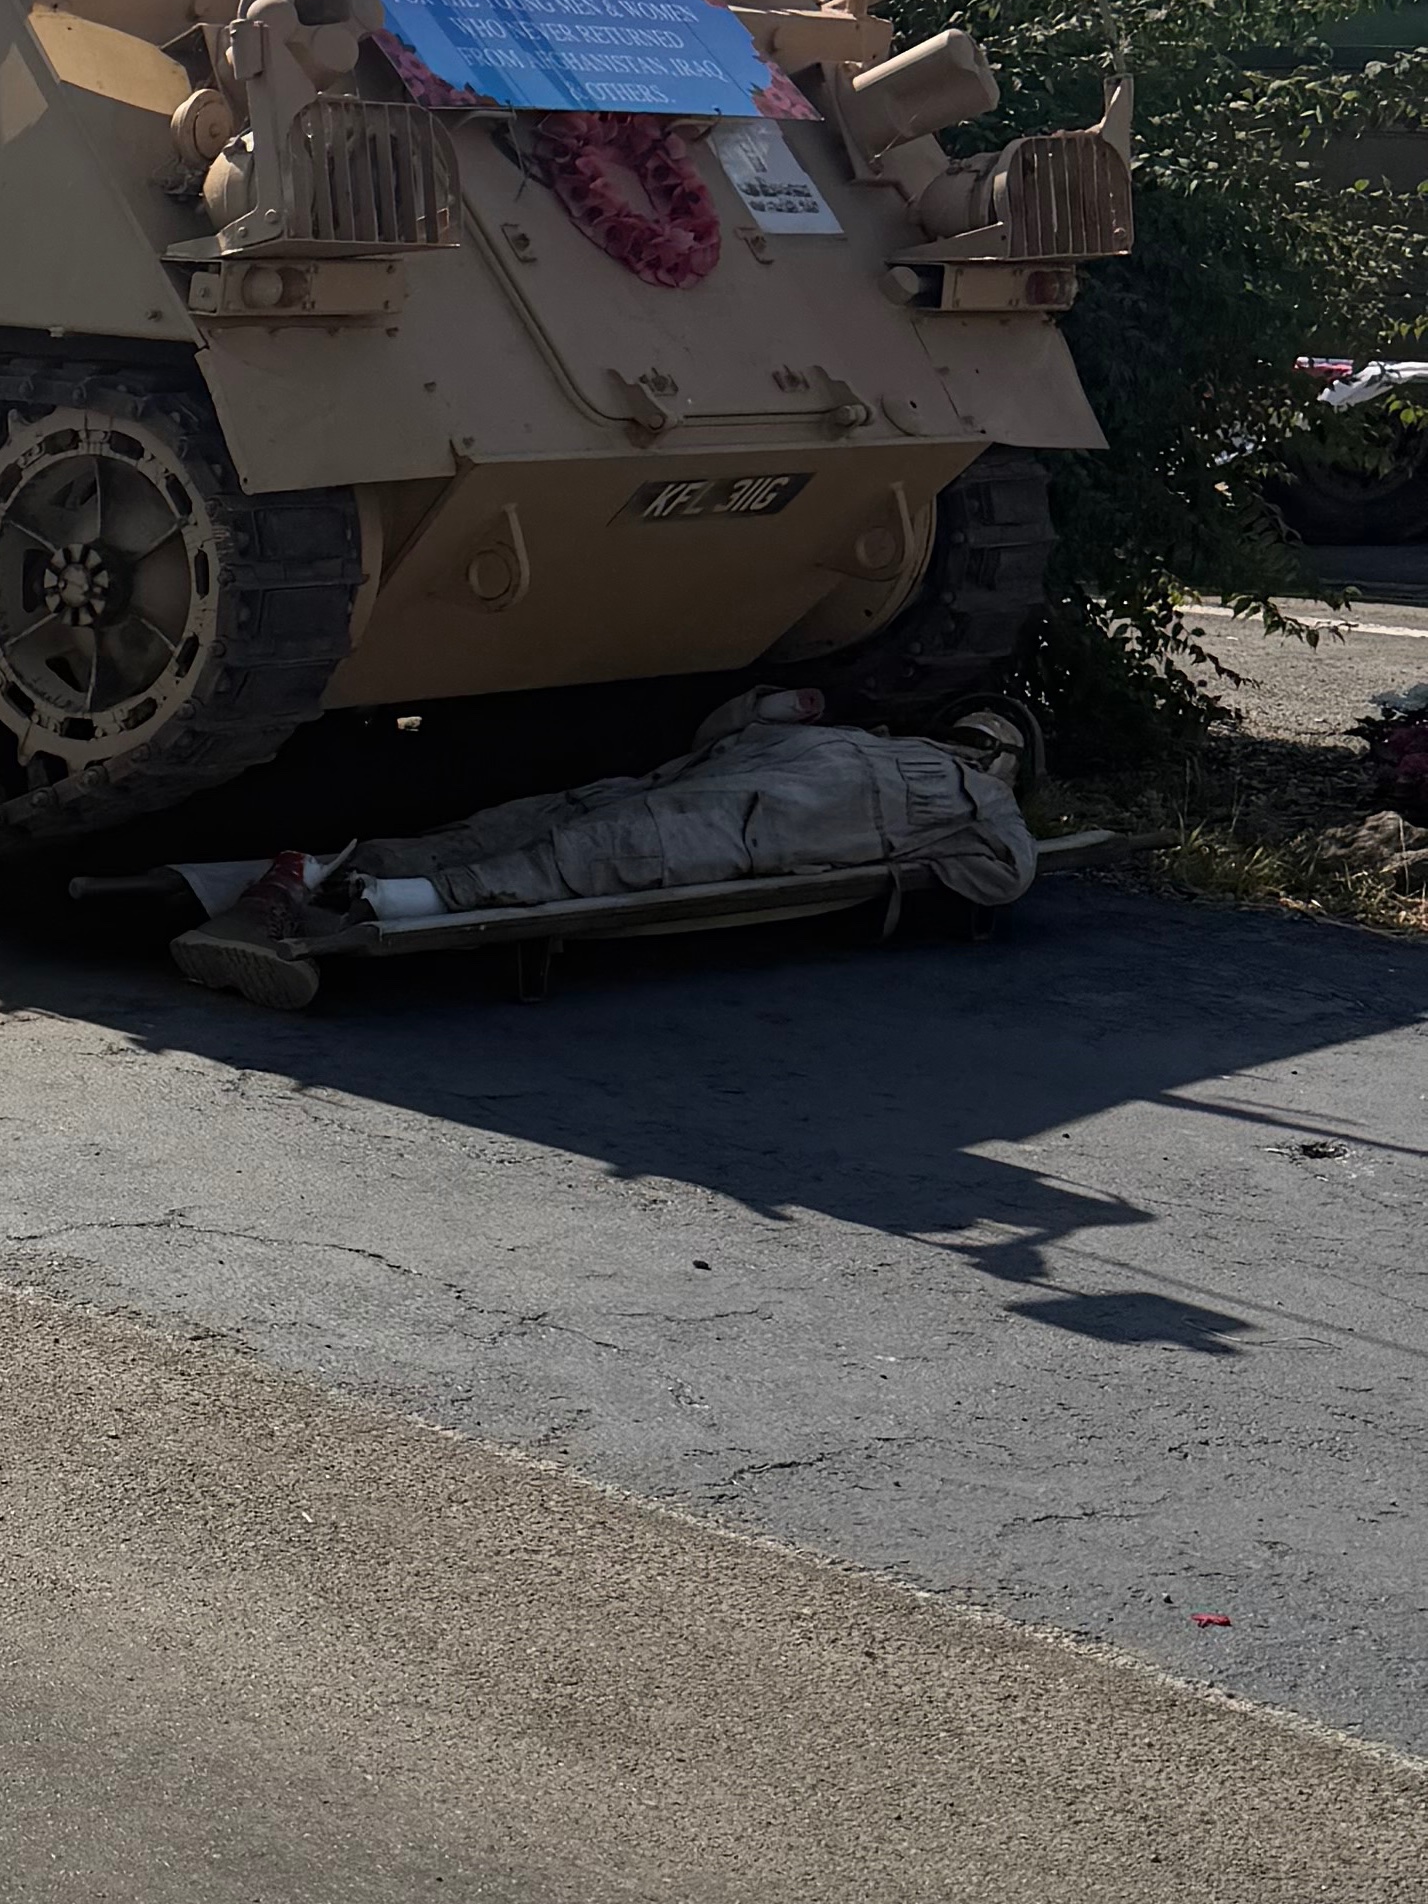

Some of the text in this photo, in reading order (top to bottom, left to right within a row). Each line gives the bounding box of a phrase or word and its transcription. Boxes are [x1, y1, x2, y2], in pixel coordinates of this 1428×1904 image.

[602, 0, 625, 18] &
[618, 0, 700, 23] WOMEN
[449, 16, 685, 49] WHO NEVER RETURNED
[457, 47, 525, 69] FROM
[642, 476, 791, 517] KFL 311G
